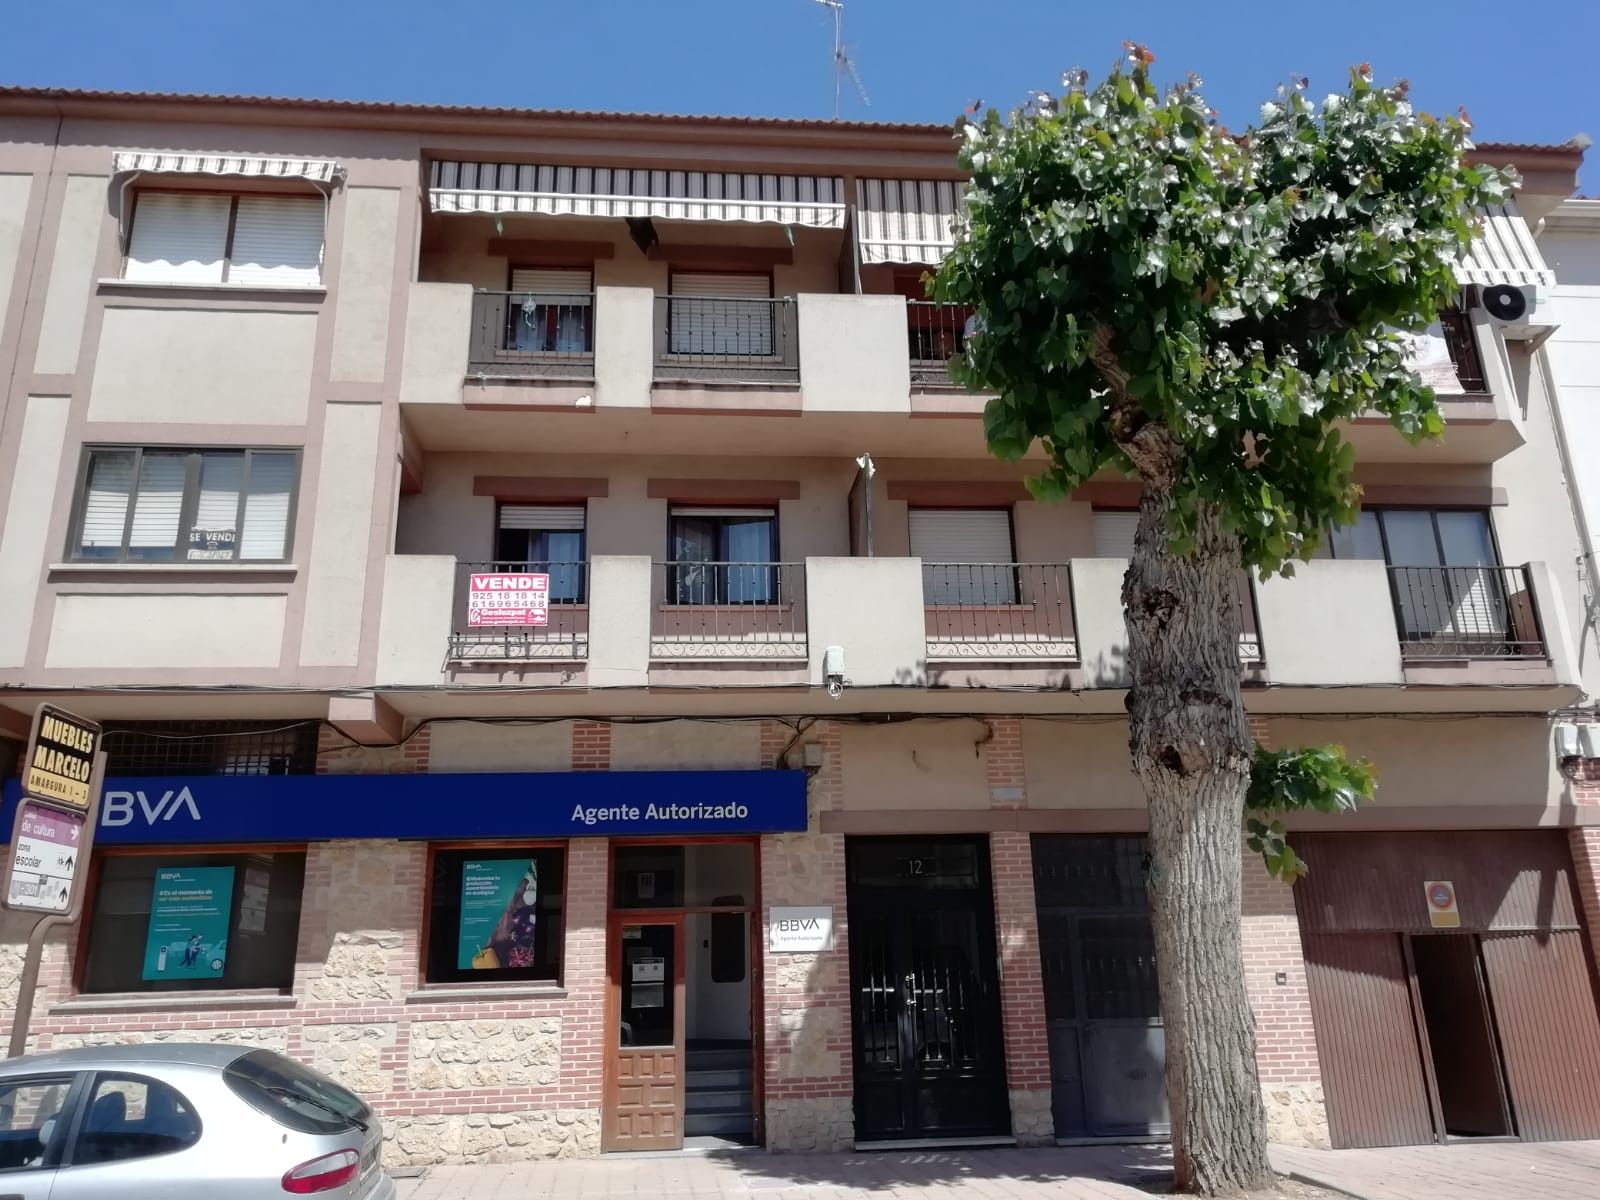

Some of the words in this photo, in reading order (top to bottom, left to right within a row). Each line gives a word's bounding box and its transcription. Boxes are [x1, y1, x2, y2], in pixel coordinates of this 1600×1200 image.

[189, 532, 200, 541] SE
[474, 577, 546, 590] VENDE
[472, 592, 493, 600] 925
[498, 592, 510, 600] 18
[516, 592, 528, 600] 18
[533, 592, 545, 600] 14
[472, 600, 545, 608] 616965468
[41, 716, 93, 753] MUEBLES
[34, 745, 90, 782] MARCELO
[30, 775, 66, 793] AMARGURA
[101, 785, 202, 826] BVA
[571, 804, 640, 825] Agente
[645, 802, 748, 820] Autorizado
[21, 820, 31, 832] de
[33, 824, 55, 838] cultura
[15, 855, 42, 868] escolar
[909, 860, 922, 874] 12
[780, 917, 819, 931] BBVA
